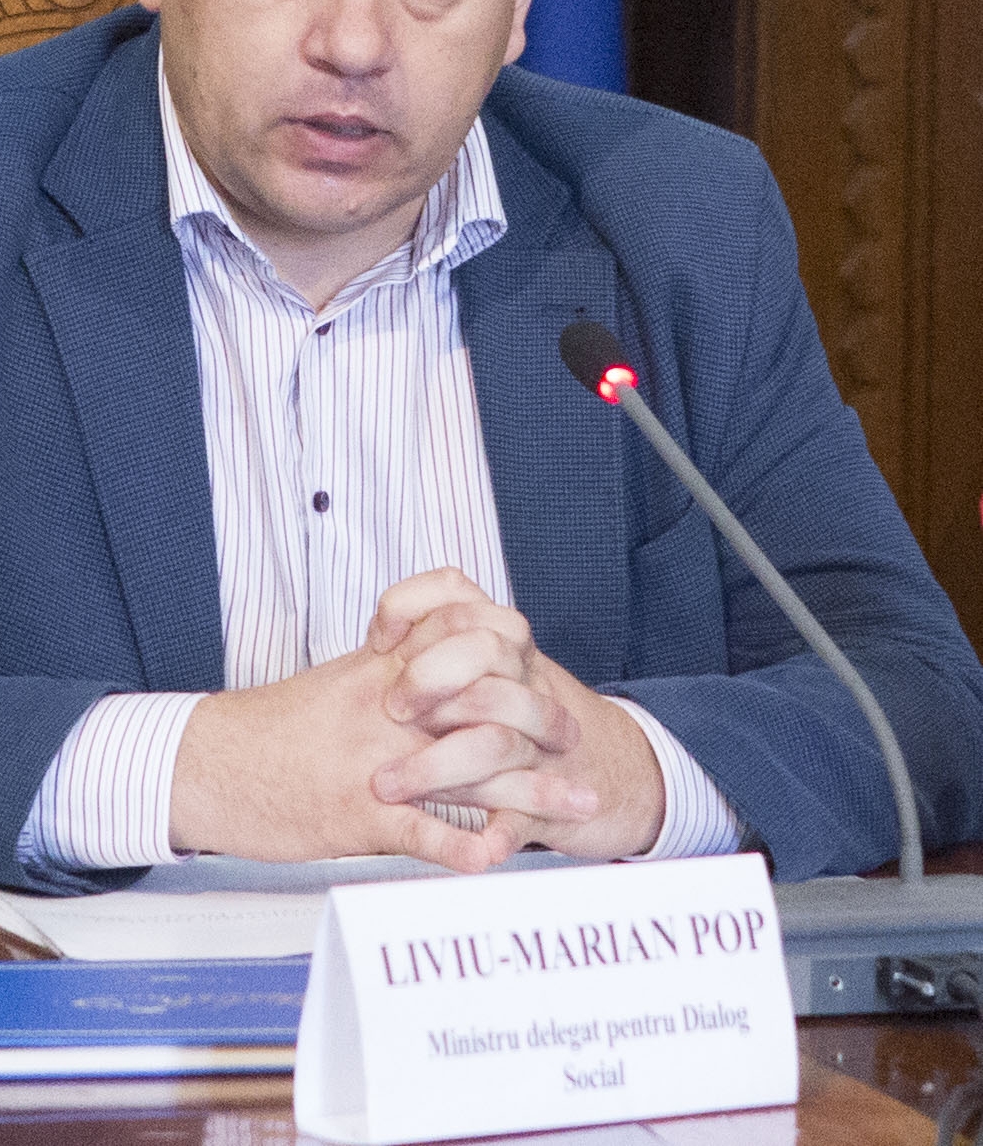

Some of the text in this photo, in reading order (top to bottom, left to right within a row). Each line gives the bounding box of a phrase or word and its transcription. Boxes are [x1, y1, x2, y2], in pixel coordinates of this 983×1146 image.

[380, 908, 766, 988] LIVIU-MARIAN POP
[427, 1001, 752, 1058] Ministru delegat pentru Dialog
[563, 1059, 626, 1092] Social
